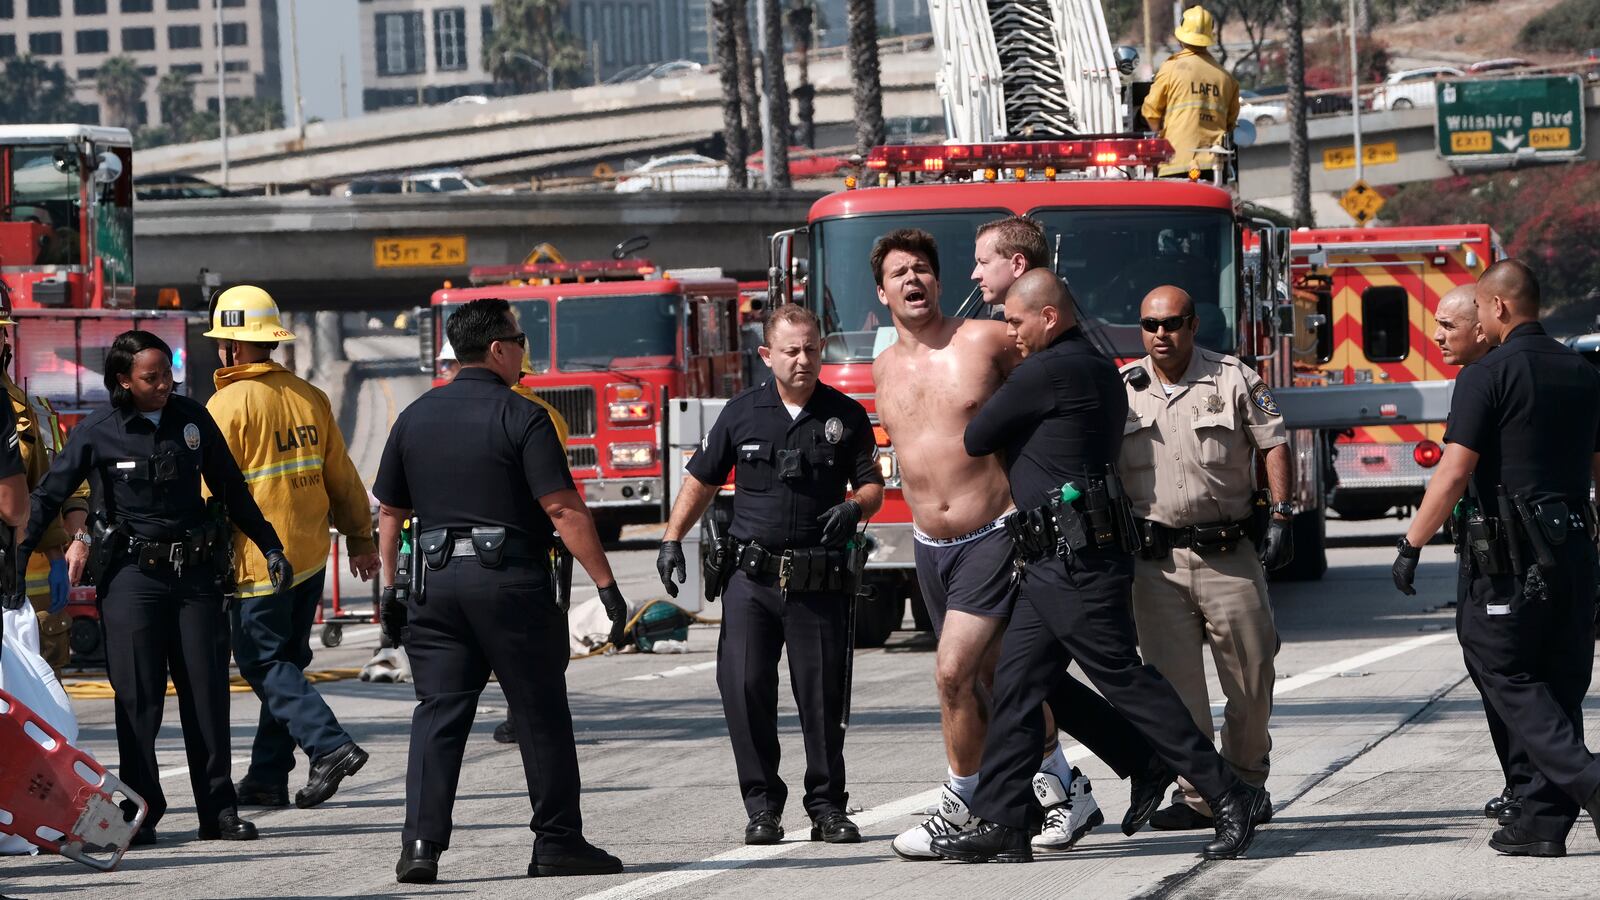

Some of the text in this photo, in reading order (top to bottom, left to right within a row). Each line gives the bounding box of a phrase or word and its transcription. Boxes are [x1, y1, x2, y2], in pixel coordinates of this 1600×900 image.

[1191, 82, 1220, 97] LAFD
[1446, 111, 1573, 129] Wilshire Blvd
[1455, 134, 1565, 148] EXIT ONLY
[382, 243, 401, 261] 15
[403, 248, 419, 259] FT
[430, 242, 443, 260] 2
[225, 310, 239, 326] 10
[274, 425, 319, 453] LAFD
[955, 521, 997, 542] HILFIGER
